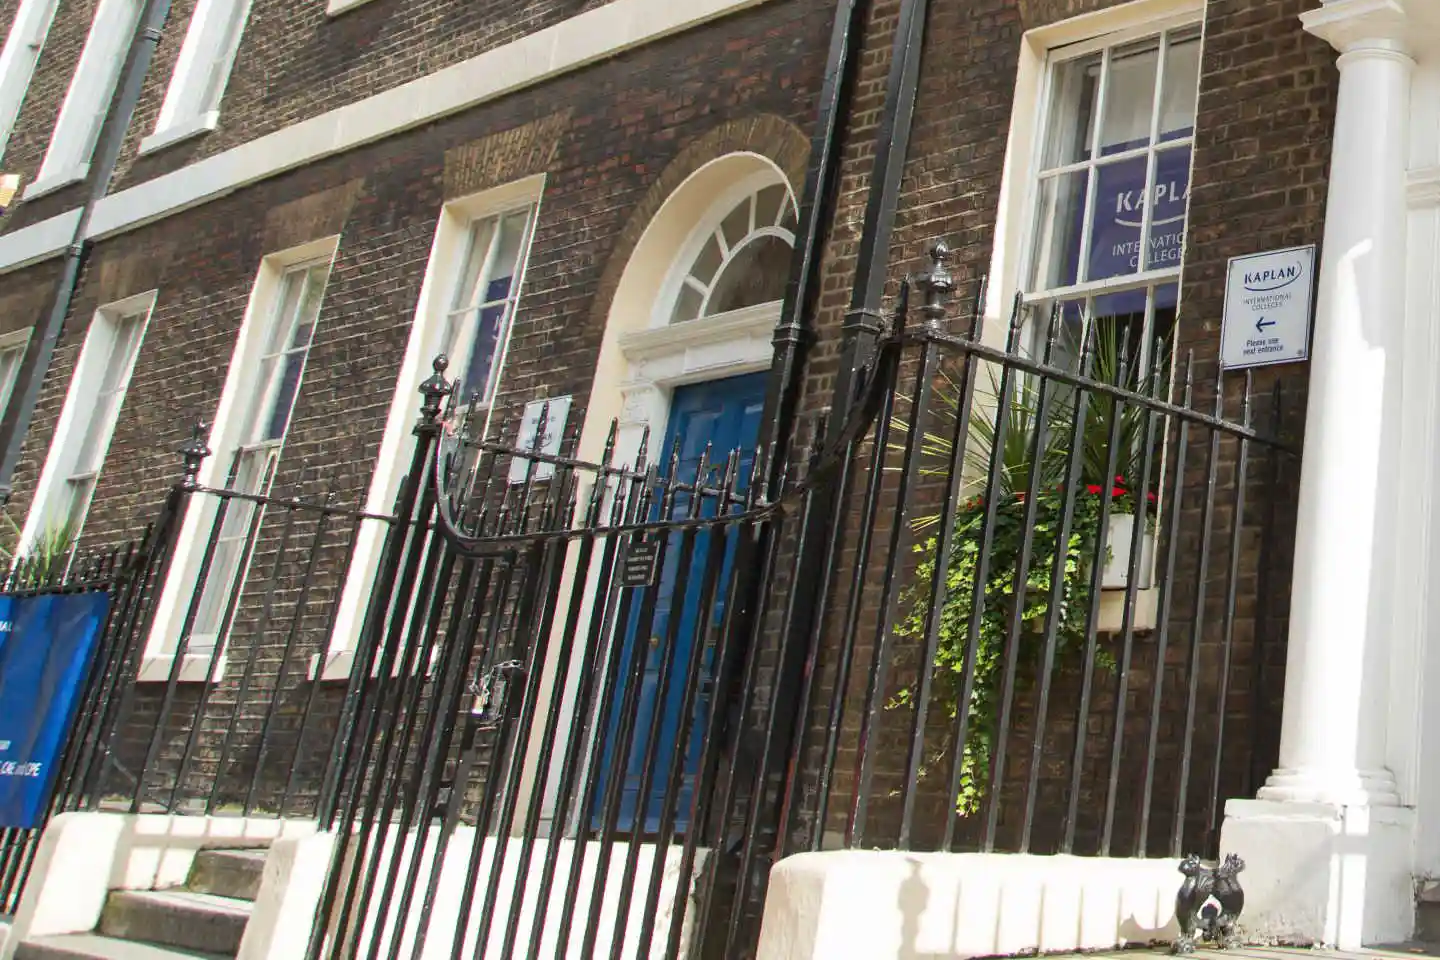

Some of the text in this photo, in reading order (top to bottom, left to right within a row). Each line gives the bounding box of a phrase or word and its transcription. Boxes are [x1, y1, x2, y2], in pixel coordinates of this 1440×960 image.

[1244, 266, 1296, 284] KAPLAN
[1243, 292, 1292, 305] INTERNATIONAL
[1252, 301, 1283, 312] COLLEGES
[1246, 339, 1266, 348] Please
[1243, 345, 1284, 356] next entrance
